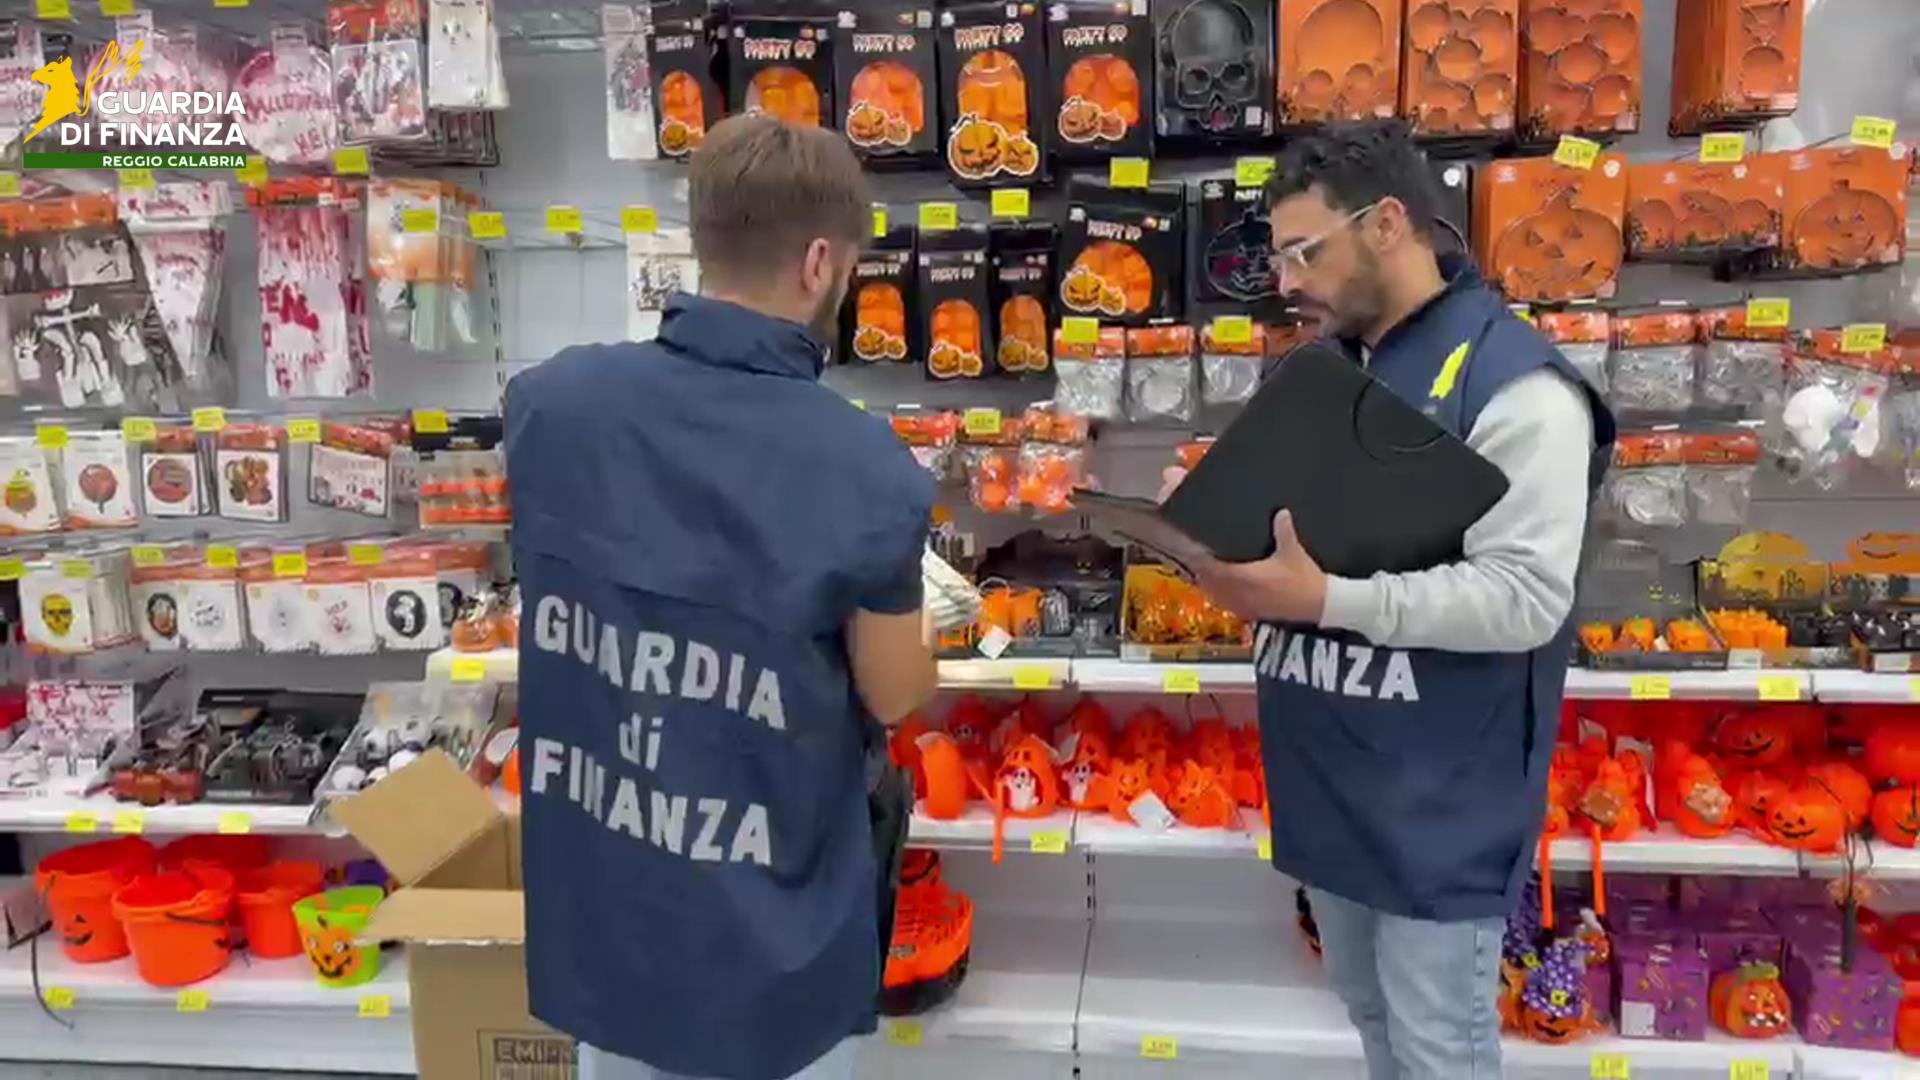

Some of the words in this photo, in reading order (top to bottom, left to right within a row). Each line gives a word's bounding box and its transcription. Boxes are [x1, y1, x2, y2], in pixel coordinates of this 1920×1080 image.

[534, 594, 787, 730] GUARDIA
[530, 736, 772, 867] FINANZA
[619, 712, 664, 771] di
